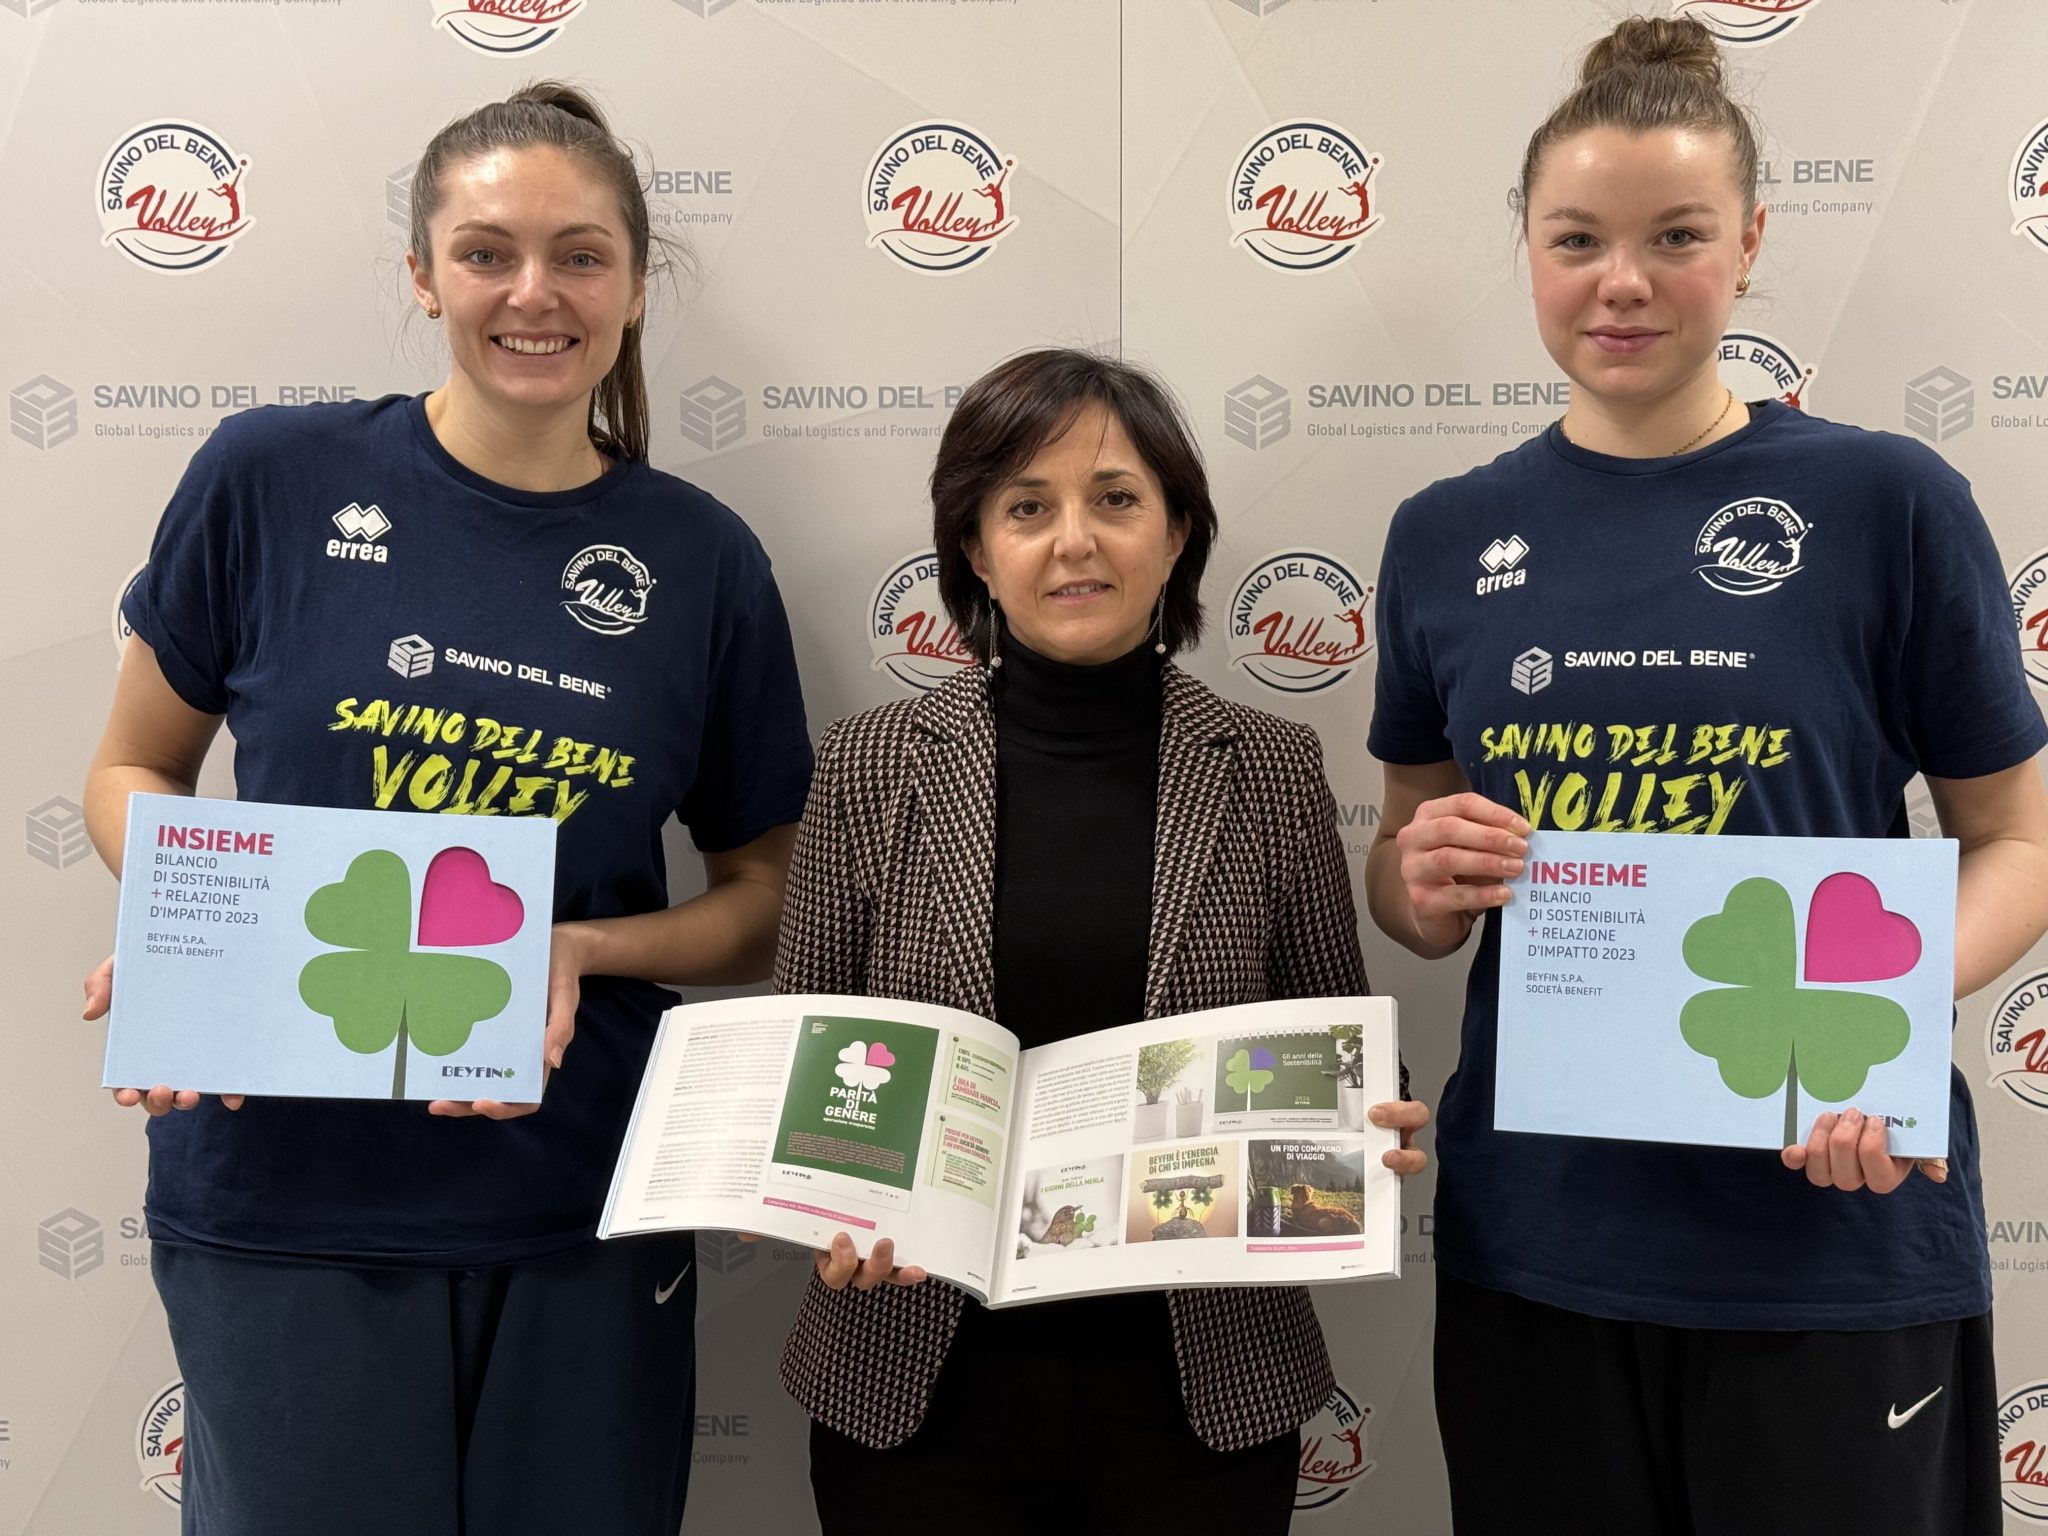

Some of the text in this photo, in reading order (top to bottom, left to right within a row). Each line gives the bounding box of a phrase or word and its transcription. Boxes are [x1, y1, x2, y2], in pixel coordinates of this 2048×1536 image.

[107, 134, 230, 210] SAVINO DEL BENE
[873, 135, 996, 211] SAVINO DEL BENE
[1237, 134, 1361, 211] SAVINO DEL BENE
[1756, 159, 1874, 184] EL BENE
[655, 171, 732, 194] BENE
[125, 184, 218, 237] Volley
[891, 185, 982, 238] Volley
[1255, 184, 1346, 237] Volley
[1767, 200, 1873, 215] arding Company
[674, 211, 733, 227] Company
[1750, 347, 1794, 389] BENE
[93, 385, 201, 409] SAVINO
[211, 385, 263, 408] DEL
[762, 385, 868, 409] SAVINO
[878, 386, 934, 409] DEL
[1307, 382, 1571, 408] SAVINO DEL BENE
[94, 424, 212, 439] Global Logistics an
[763, 424, 942, 440] Global Logistics and Forward
[1307, 423, 1347, 436] Global
[1350, 423, 1405, 438] Logistics
[1409, 423, 1433, 435] and
[1437, 422, 1508, 437] Forwarding
[1991, 415, 2032, 428] Global
[1698, 504, 1798, 553] SAVINO DEL BENE
[1713, 536, 1780, 575] Volley
[564, 550, 645, 590] SAVINO DEL BENE
[575, 578, 634, 618] Volley
[878, 563, 940, 636] SAVINO DE
[1235, 562, 1356, 636] SAVINO DEL BENE
[895, 610, 969, 657] Volle
[1253, 610, 1342, 662] Volley
[445, 647, 513, 676] SAVINO
[517, 664, 554, 686] DEL
[1564, 650, 1636, 667] SAVINO
[1642, 650, 1682, 666] DEL
[328, 697, 637, 788] SAVINO DEL BENE
[1480, 720, 1792, 768] SAVINO DEL BENE
[372, 744, 591, 828] VOLLEY
[1514, 768, 1749, 836] VOLLEY
[157, 825, 275, 856] INSIEME
[155, 853, 218, 869] BILANCIO
[153, 870, 270, 891] DI SOSTENIBILITÀ
[1531, 861, 1648, 888] INSIEME
[165, 889, 241, 906] RELAZIONE
[1530, 890, 1592, 904] BILANCIO
[150, 905, 259, 925] D'IMPATTO 2023
[1529, 908, 1646, 924] DI SOSTENIBILITÀ
[147, 932, 207, 945] BEYFIN S.P.A.
[1542, 927, 1616, 942] RELAZIONE
[146, 944, 225, 958] SOCIETÀ BENEFIT
[1528, 945, 1636, 961] D'IMPATTO 2023
[1526, 972, 1585, 983] BEYFIN S.P.A.
[1525, 983, 1603, 996] SOCIETÀ BENEFIT
[1996, 991, 2035, 1053] SAVINO
[442, 1065, 504, 1079] BEYFIN
[829, 1086, 878, 1105] PARITÀ
[845, 1098, 860, 1111] DI
[825, 1105, 878, 1124] GENERE
[1182, 1146, 1219, 1160] L'ENERGIA
[1270, 1144, 1342, 1153] UN FIDO COMPAGNO
[1286, 1152, 1325, 1161] DI VIAGGIO
[1149, 1157, 1216, 1175] DI CHI SI IMPEGNA
[1987, 1221, 2048, 1243] AVIN
[120, 1254, 148, 1266] Glob
[772, 1248, 812, 1262] Global
[1404, 1251, 1427, 1263] and
[1325, 1394, 1354, 1427] ENE
[2026, 1394, 2048, 1411] DE
[146, 1397, 182, 1457] SAVINO
[694, 1415, 749, 1436] ENE
[692, 1451, 749, 1466] Company
